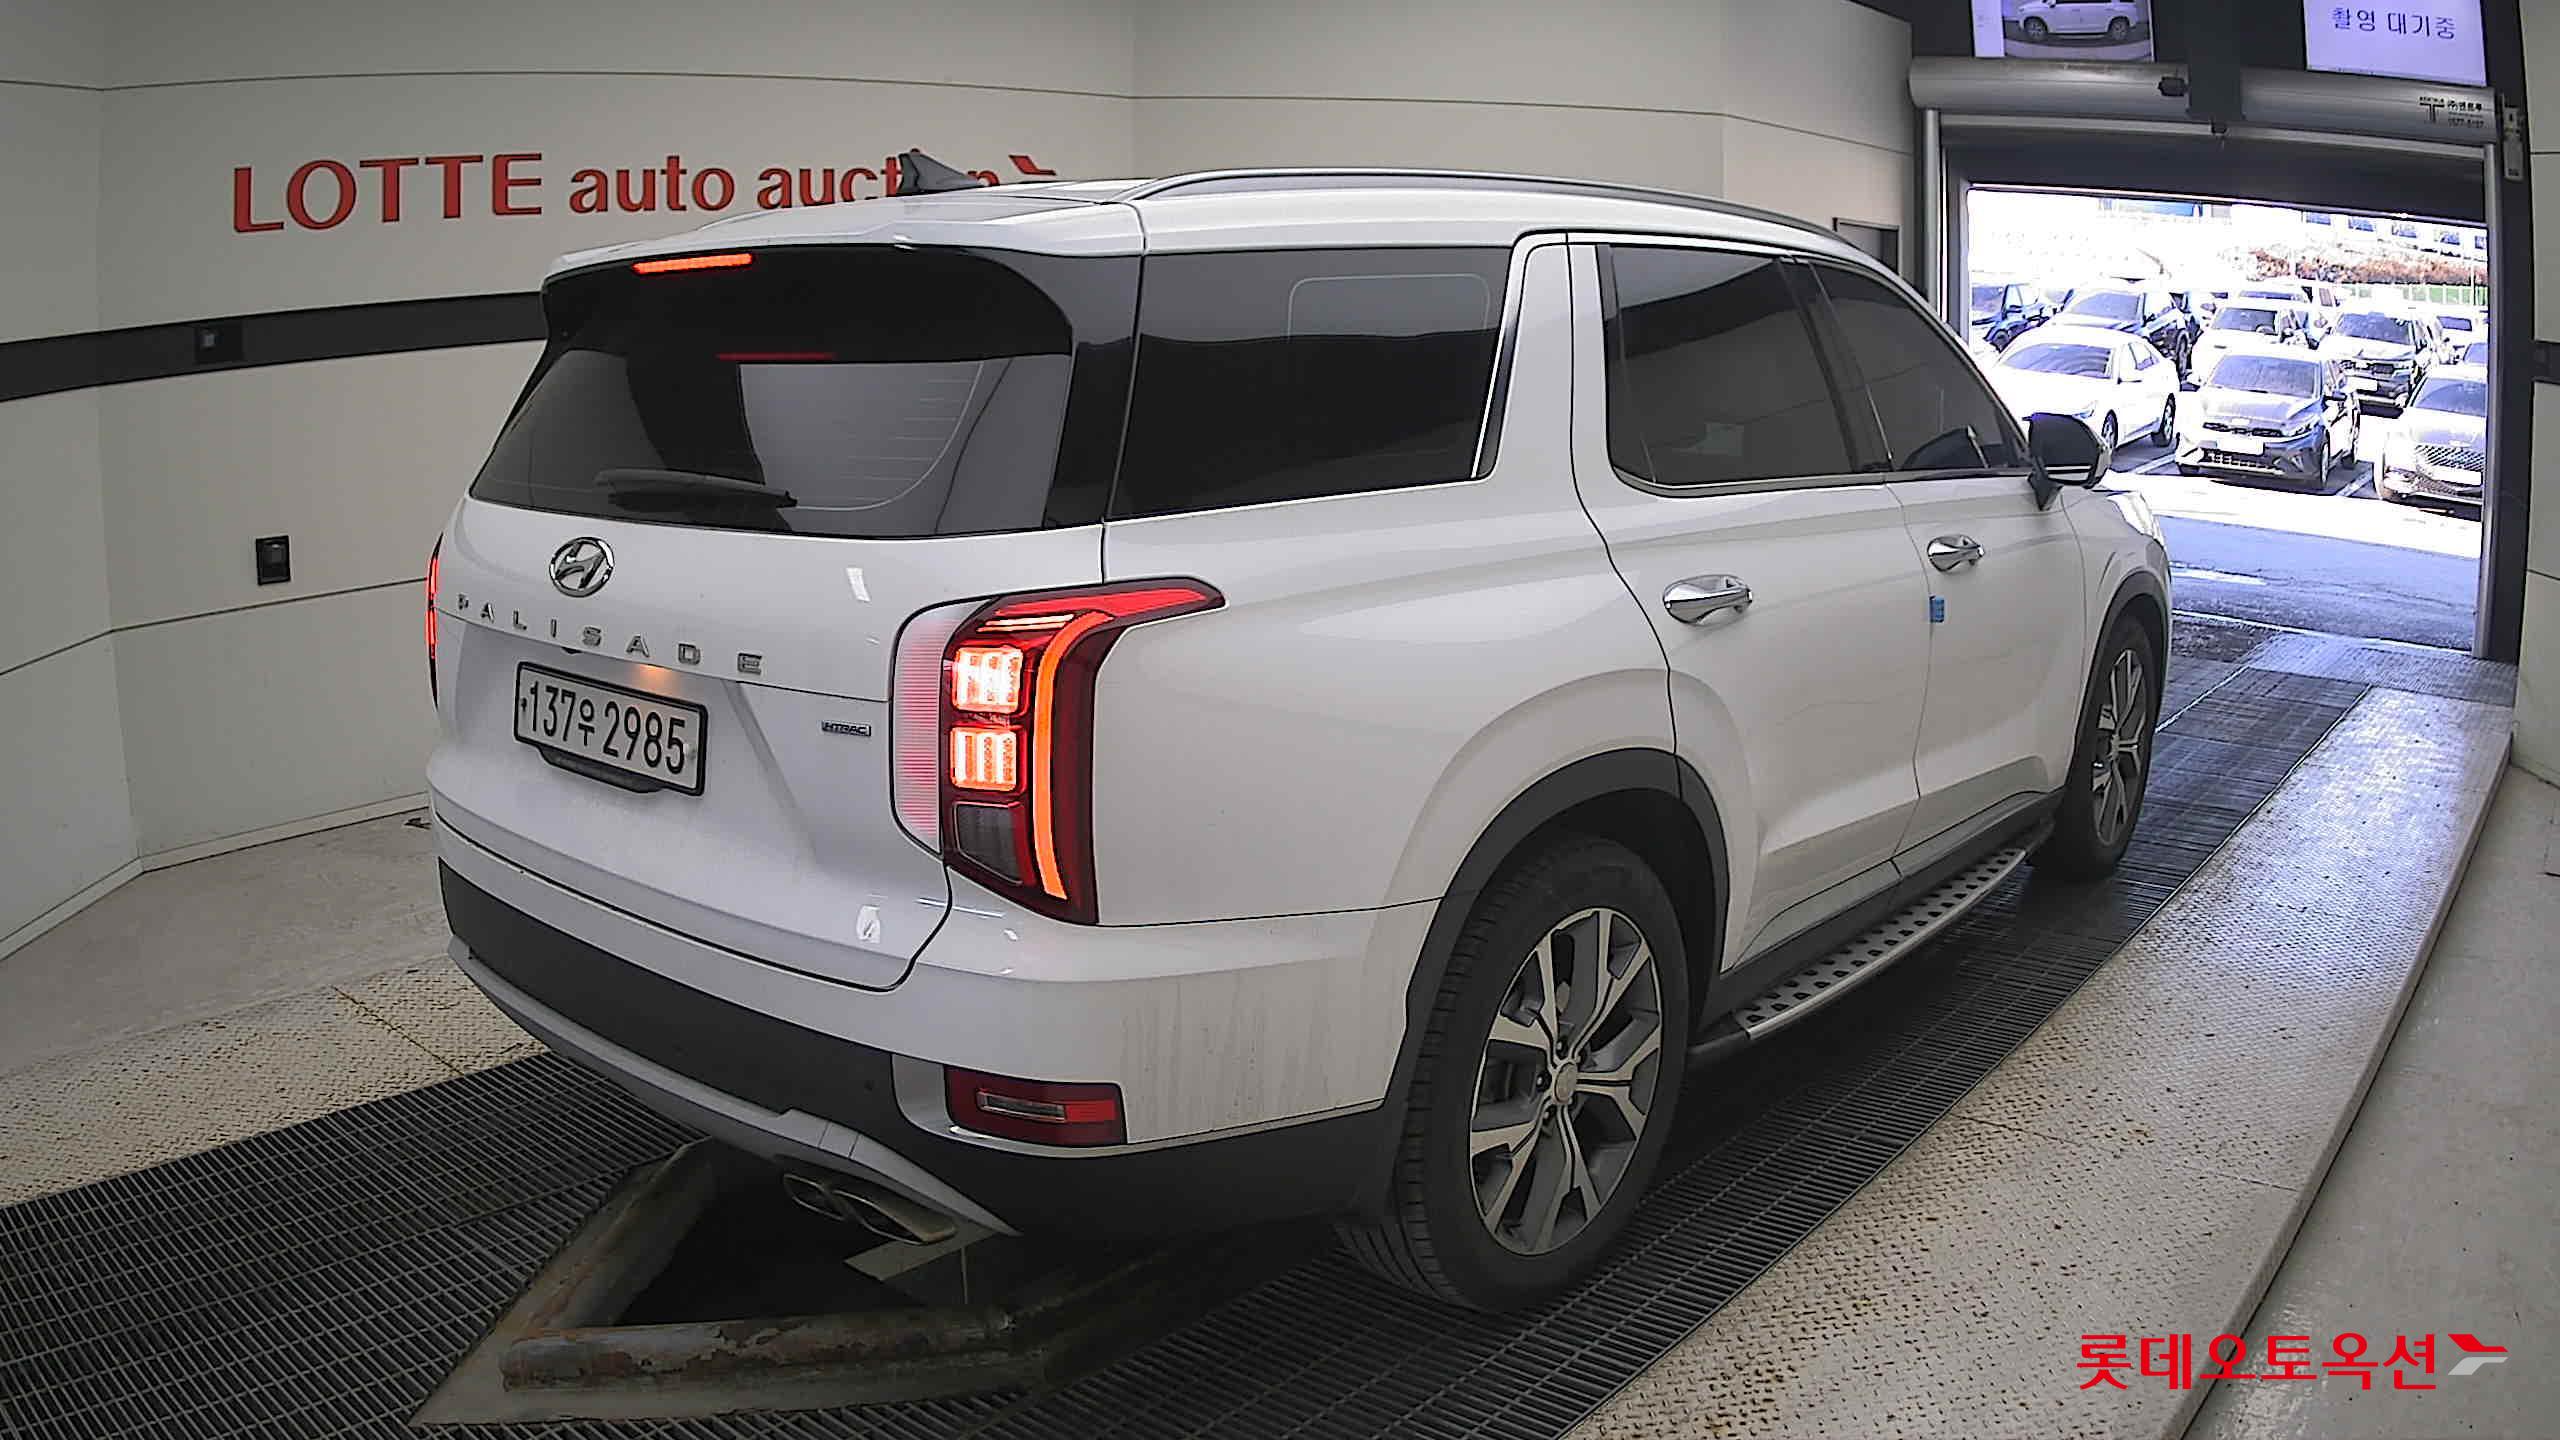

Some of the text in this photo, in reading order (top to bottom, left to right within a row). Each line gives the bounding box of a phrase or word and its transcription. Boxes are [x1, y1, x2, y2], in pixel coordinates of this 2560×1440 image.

[2387, 12, 2456, 40] 대기중
[234, 148, 1000, 233] LOTTE auto auct
[456, 593, 764, 676] PALISADE
[602, 700, 687, 776] 2985
